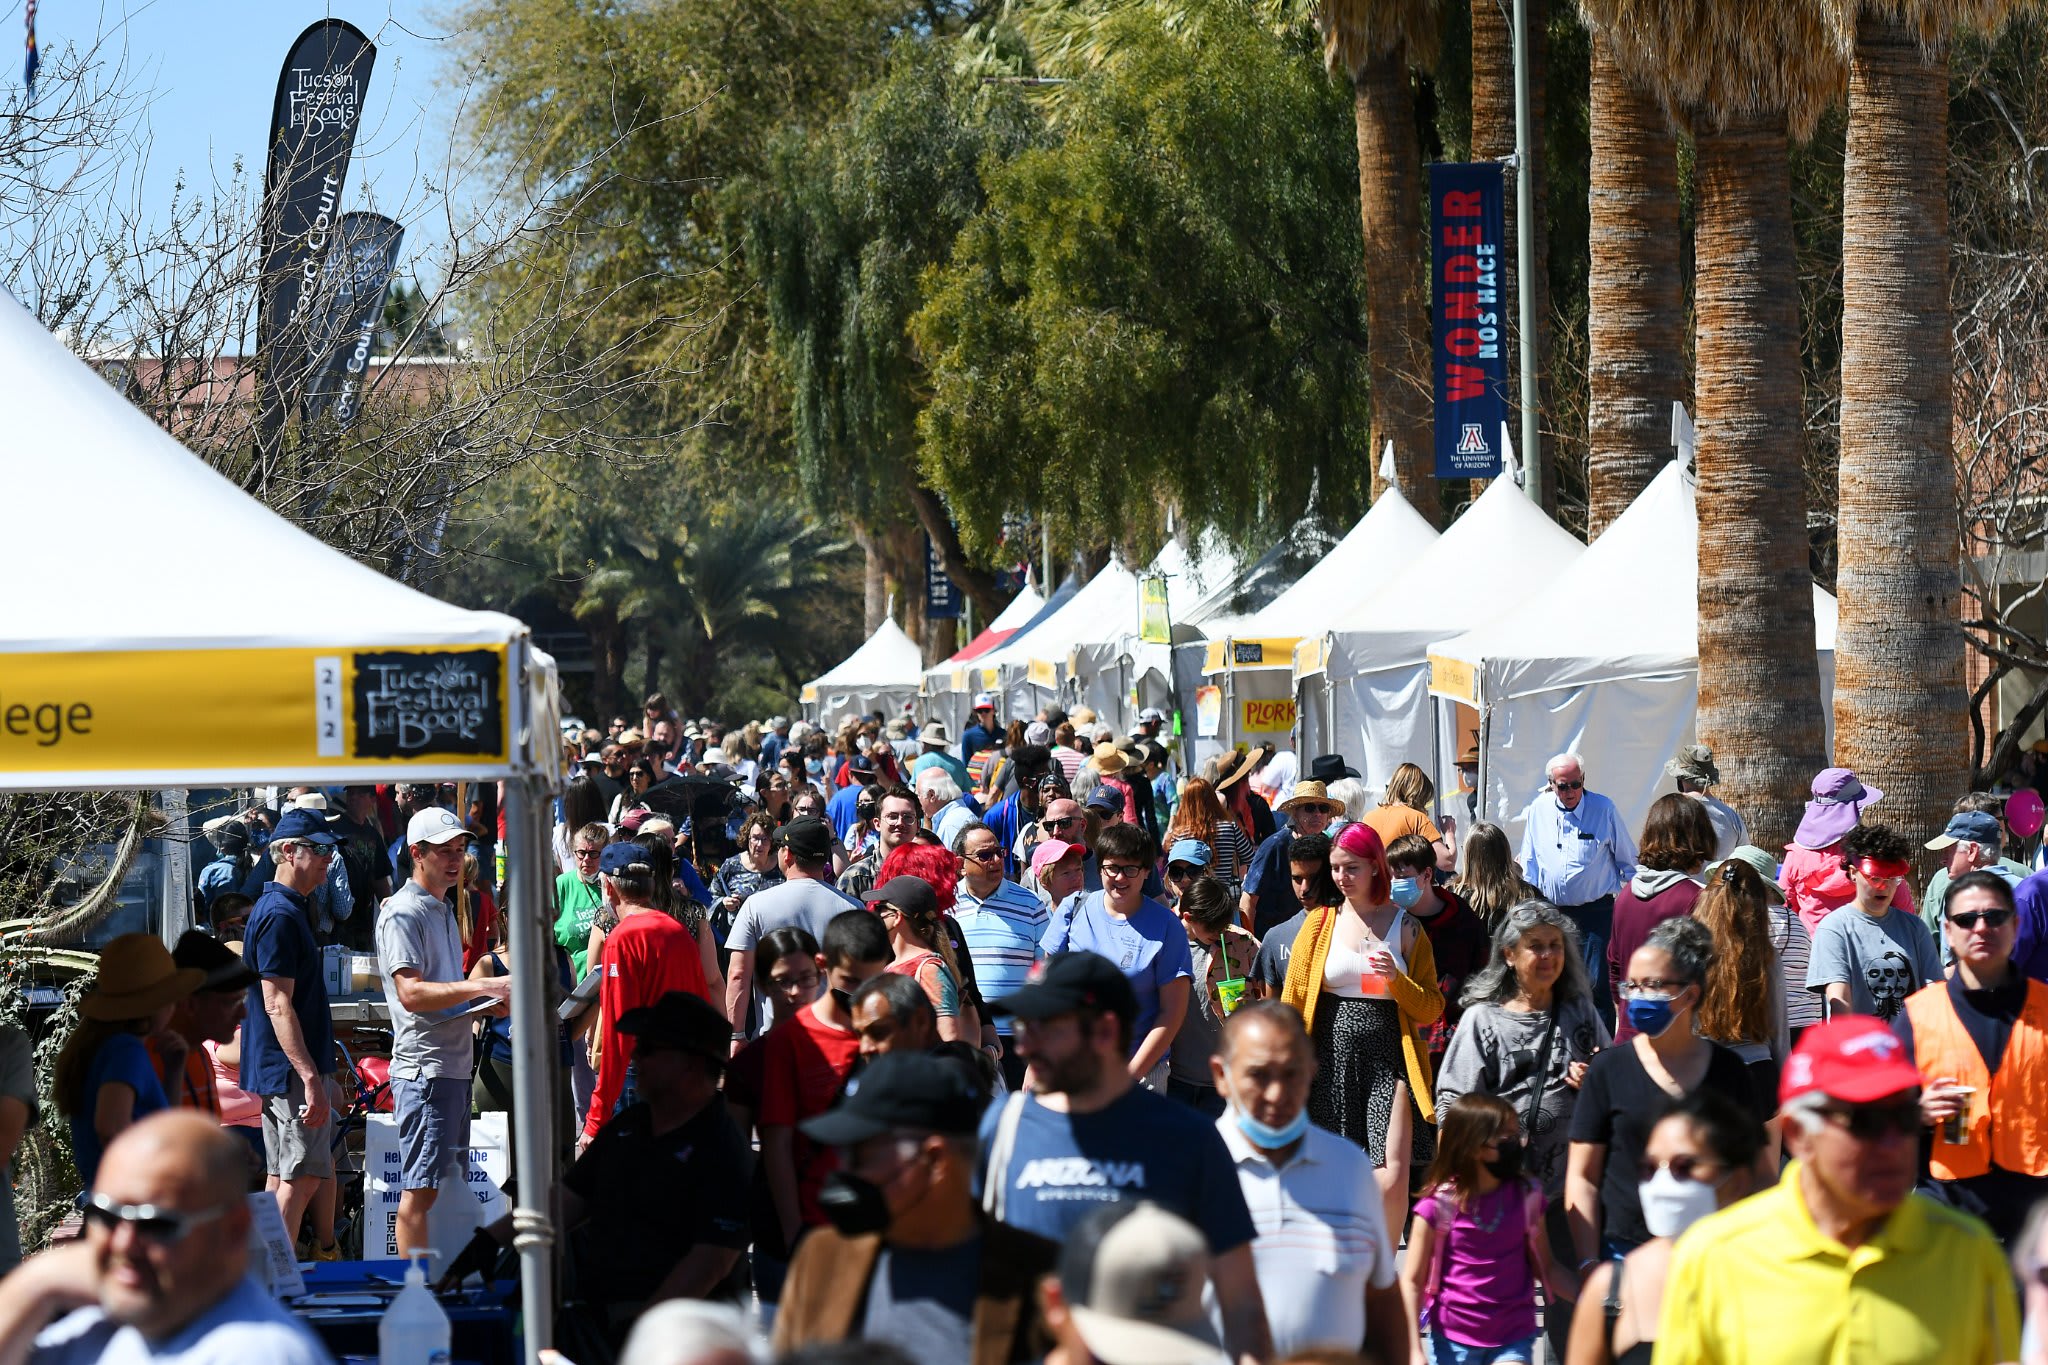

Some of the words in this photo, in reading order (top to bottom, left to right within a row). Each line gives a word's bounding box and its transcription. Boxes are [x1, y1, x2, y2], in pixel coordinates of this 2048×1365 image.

[292, 65, 352, 96] Tucson
[290, 80, 359, 129] Festival
[305, 105, 355, 137] Books
[308, 173, 340, 251] Court
[1477, 243, 1497, 304] HACE
[1442, 190, 1485, 402] WONDER
[346, 319, 375, 373] Court
[1478, 312, 1498, 359] NOS
[1450, 454, 1461, 462] THE
[1462, 454, 1496, 462] UNIVERSITY
[1463, 461, 1491, 469] ARIZONA
[367, 658, 478, 699] Tucson
[366, 677, 489, 739] Festival
[398, 707, 484, 749] Books
[1246, 701, 1297, 725] PLORK
[383, 1170, 402, 1183] bal
[467, 1170, 488, 1183] 022
[384, 1150, 402, 1164] Hel
[470, 1150, 488, 1163] the
[1016, 1157, 1145, 1189] ARIZONA
